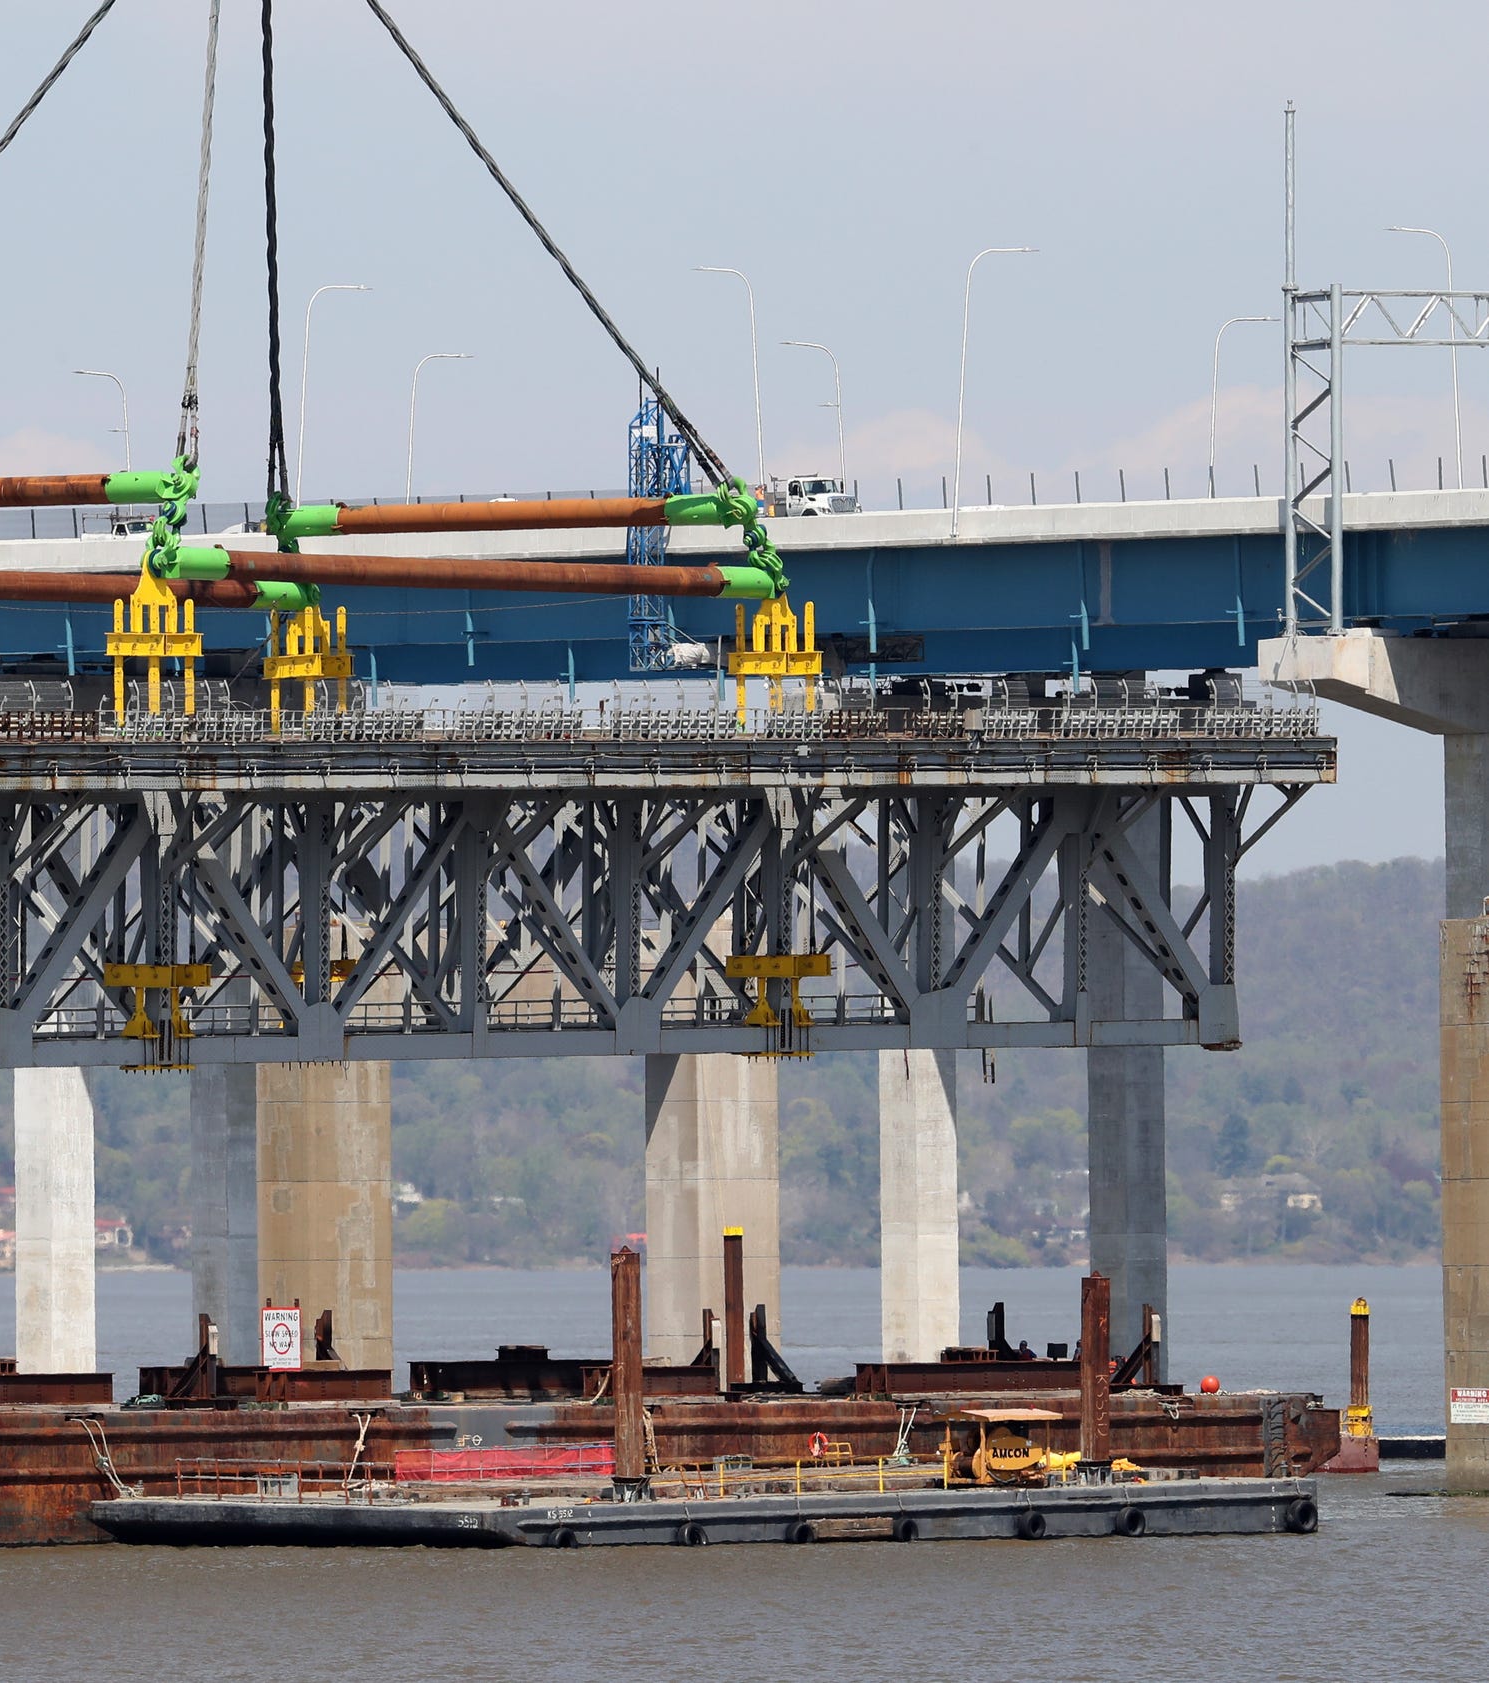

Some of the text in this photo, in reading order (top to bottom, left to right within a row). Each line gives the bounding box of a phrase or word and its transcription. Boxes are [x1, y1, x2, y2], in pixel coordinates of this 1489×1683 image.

[265, 1312, 298, 1321] WARNING
[265, 1330, 299, 1338] SLOW SPEED
[547, 1509, 574, 1520] KS 5512
[458, 1515, 479, 1529] 5512
